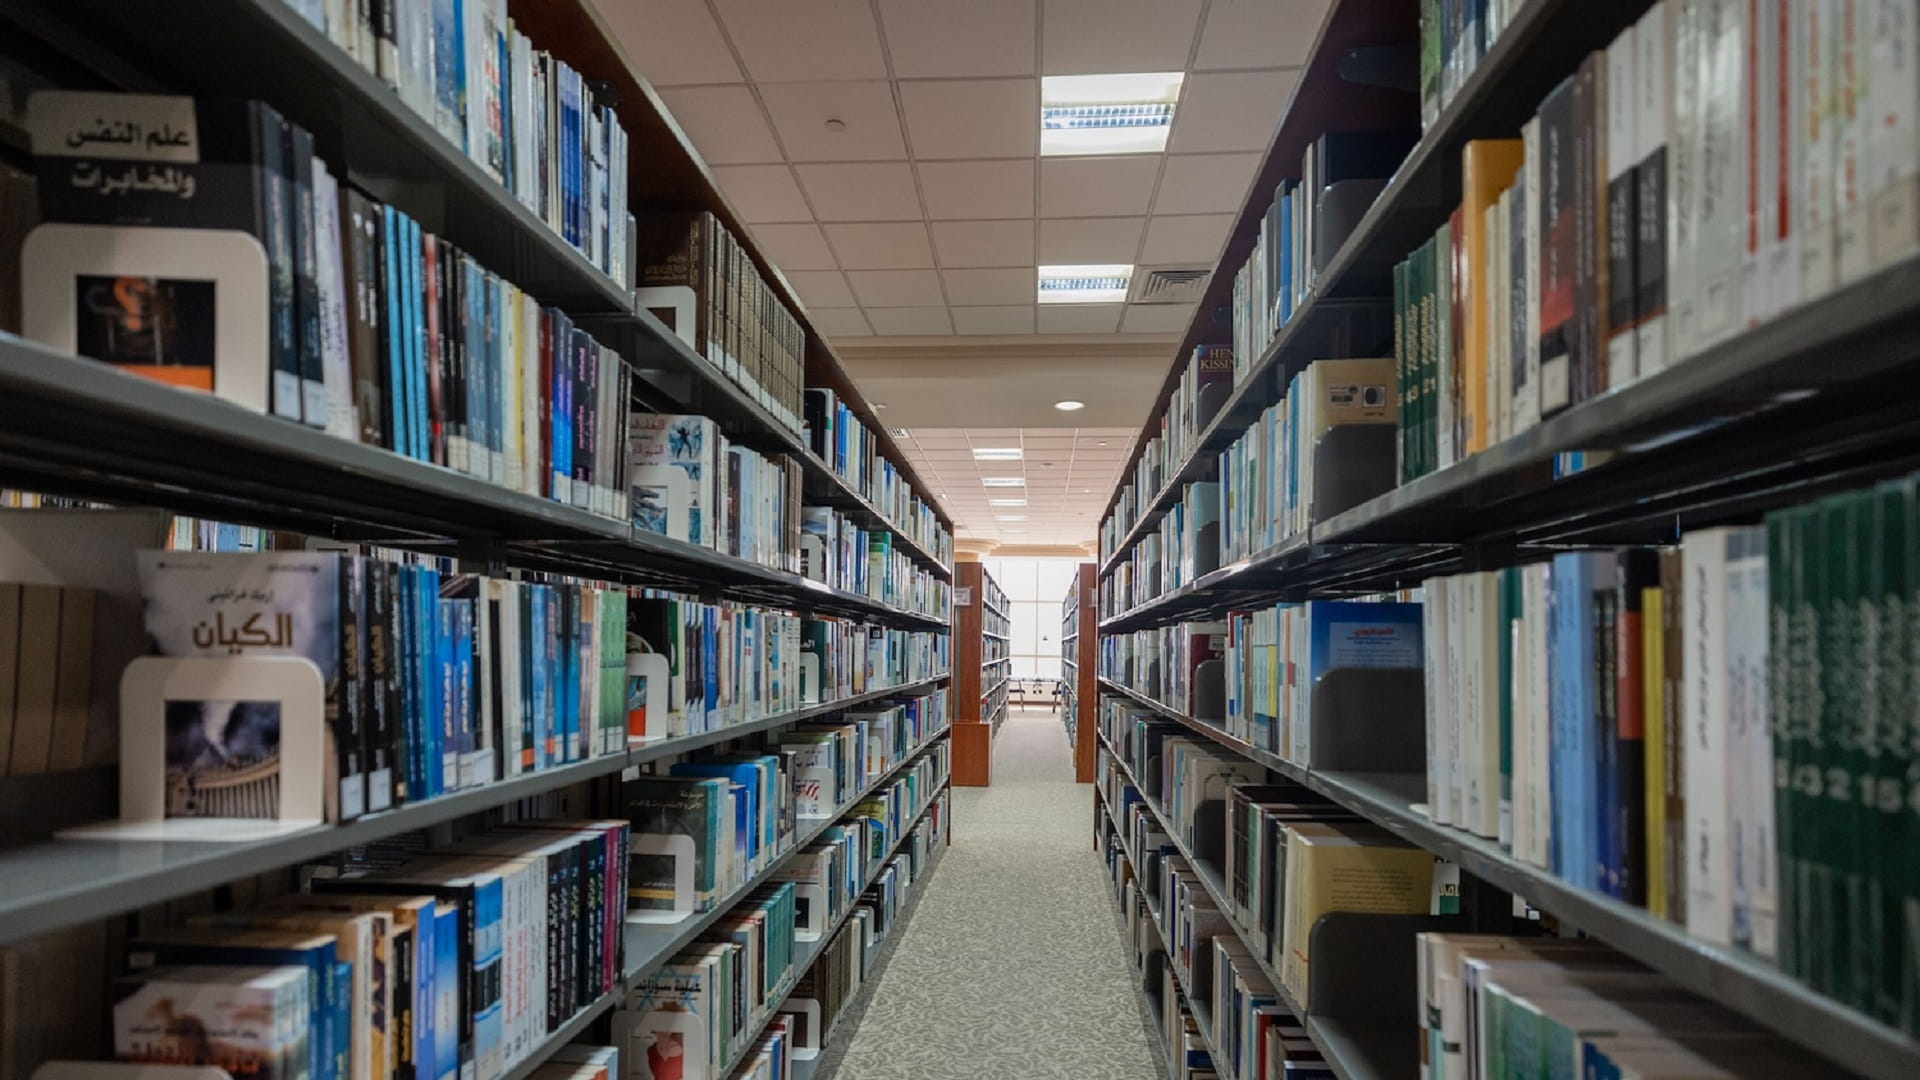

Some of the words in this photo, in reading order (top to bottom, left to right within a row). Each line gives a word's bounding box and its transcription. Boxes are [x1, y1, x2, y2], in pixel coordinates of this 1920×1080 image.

[66, 118, 142, 148] النفس
[145, 124, 191, 152] علم
[71, 161, 197, 199] والمخابرات
[192, 610, 293, 655] الكيان
